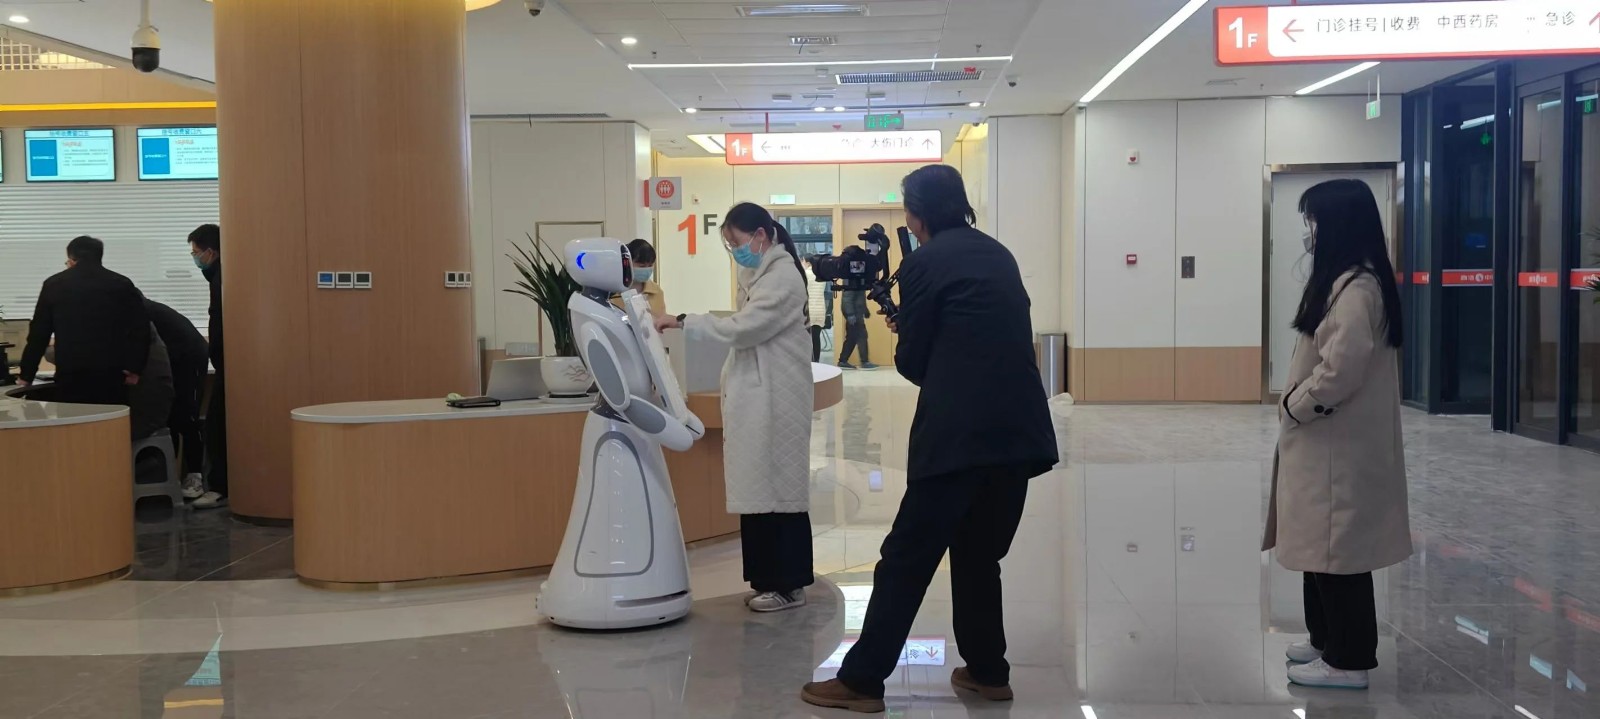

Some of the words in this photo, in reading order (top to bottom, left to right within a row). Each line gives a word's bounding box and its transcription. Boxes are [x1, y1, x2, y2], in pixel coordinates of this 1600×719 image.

[1437, 14, 1499, 29] 中西药房
[1545, 11, 1577, 27] 急诊
[1228, 17, 1258, 49] 1F
[731, 138, 748, 157] 1F
[677, 213, 718, 256] 1F
